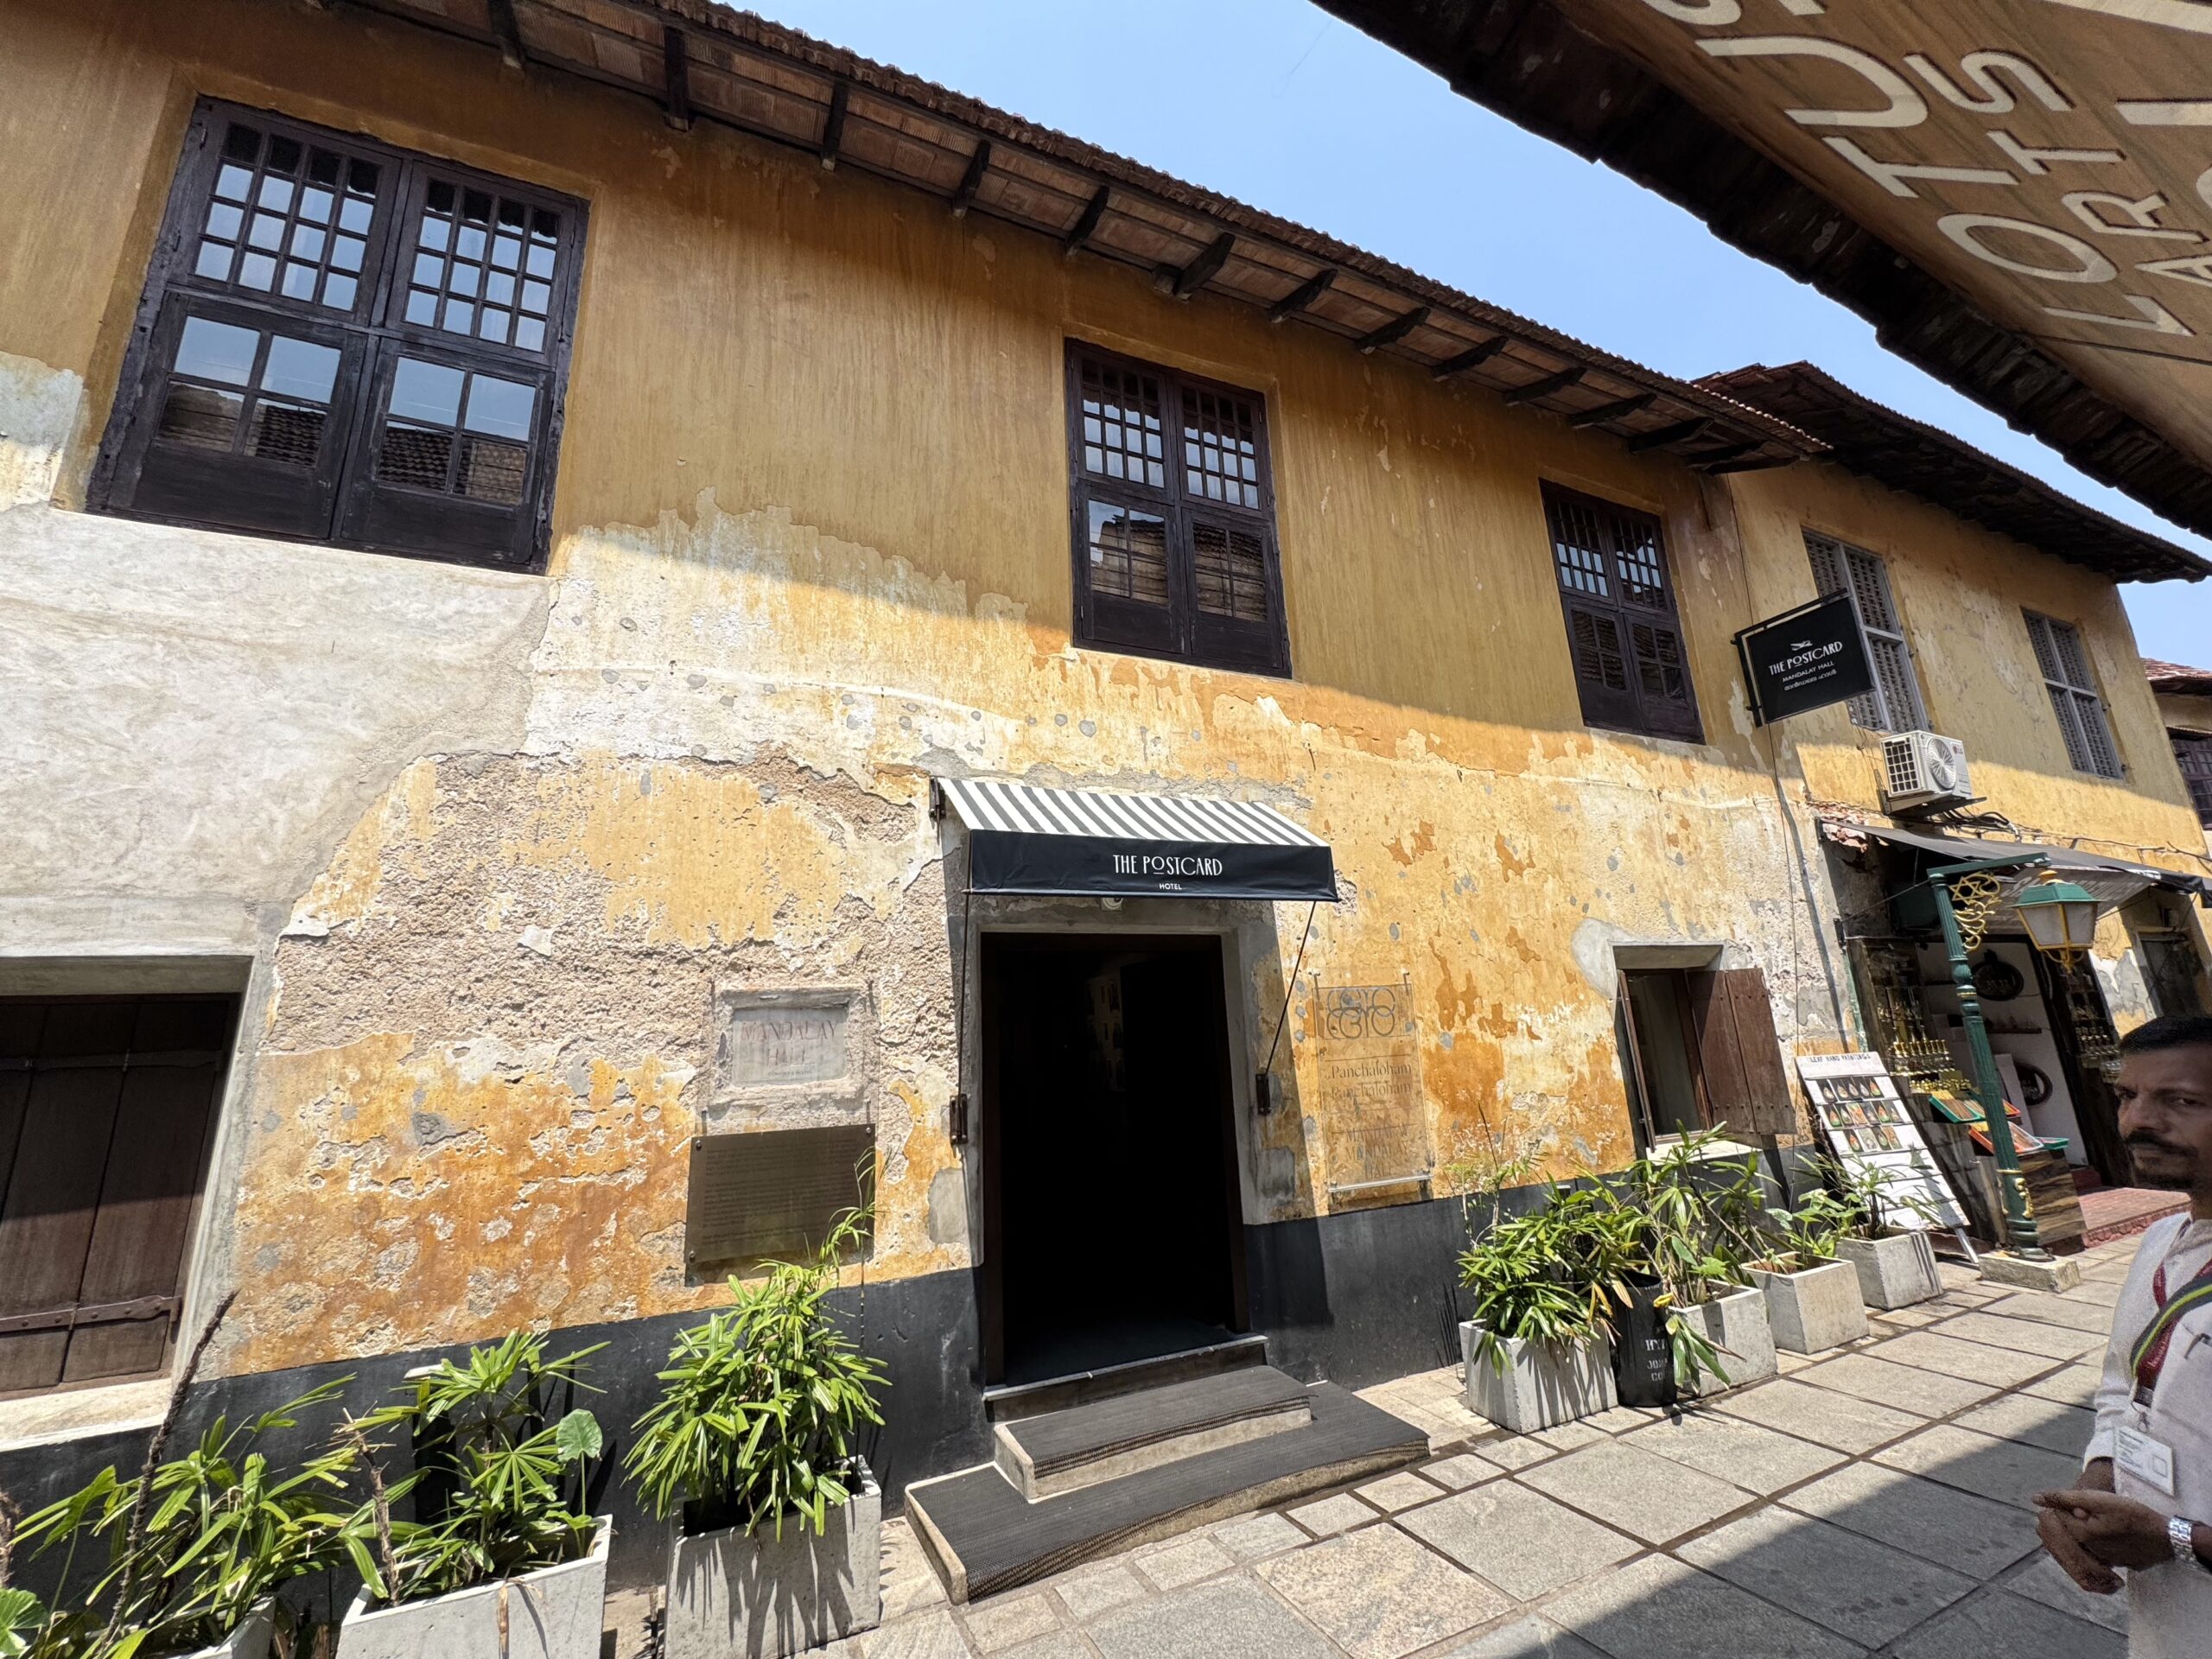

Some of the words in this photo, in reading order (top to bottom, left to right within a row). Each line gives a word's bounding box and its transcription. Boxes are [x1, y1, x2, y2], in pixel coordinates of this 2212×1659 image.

[1768, 660, 1786, 676] THE
[1787, 641, 1843, 670] POSTCARD
[1783, 666, 1816, 683] MANDALAY
[1818, 660, 1834, 670] HALL
[1112, 855, 1138, 874] THE
[1143, 855, 1223, 876] POSTCARD
[1159, 882, 1182, 891] HOTEL
[742, 1020, 838, 1041] MANDALAY
[1332, 1059, 1412, 1079] Panchaloham
